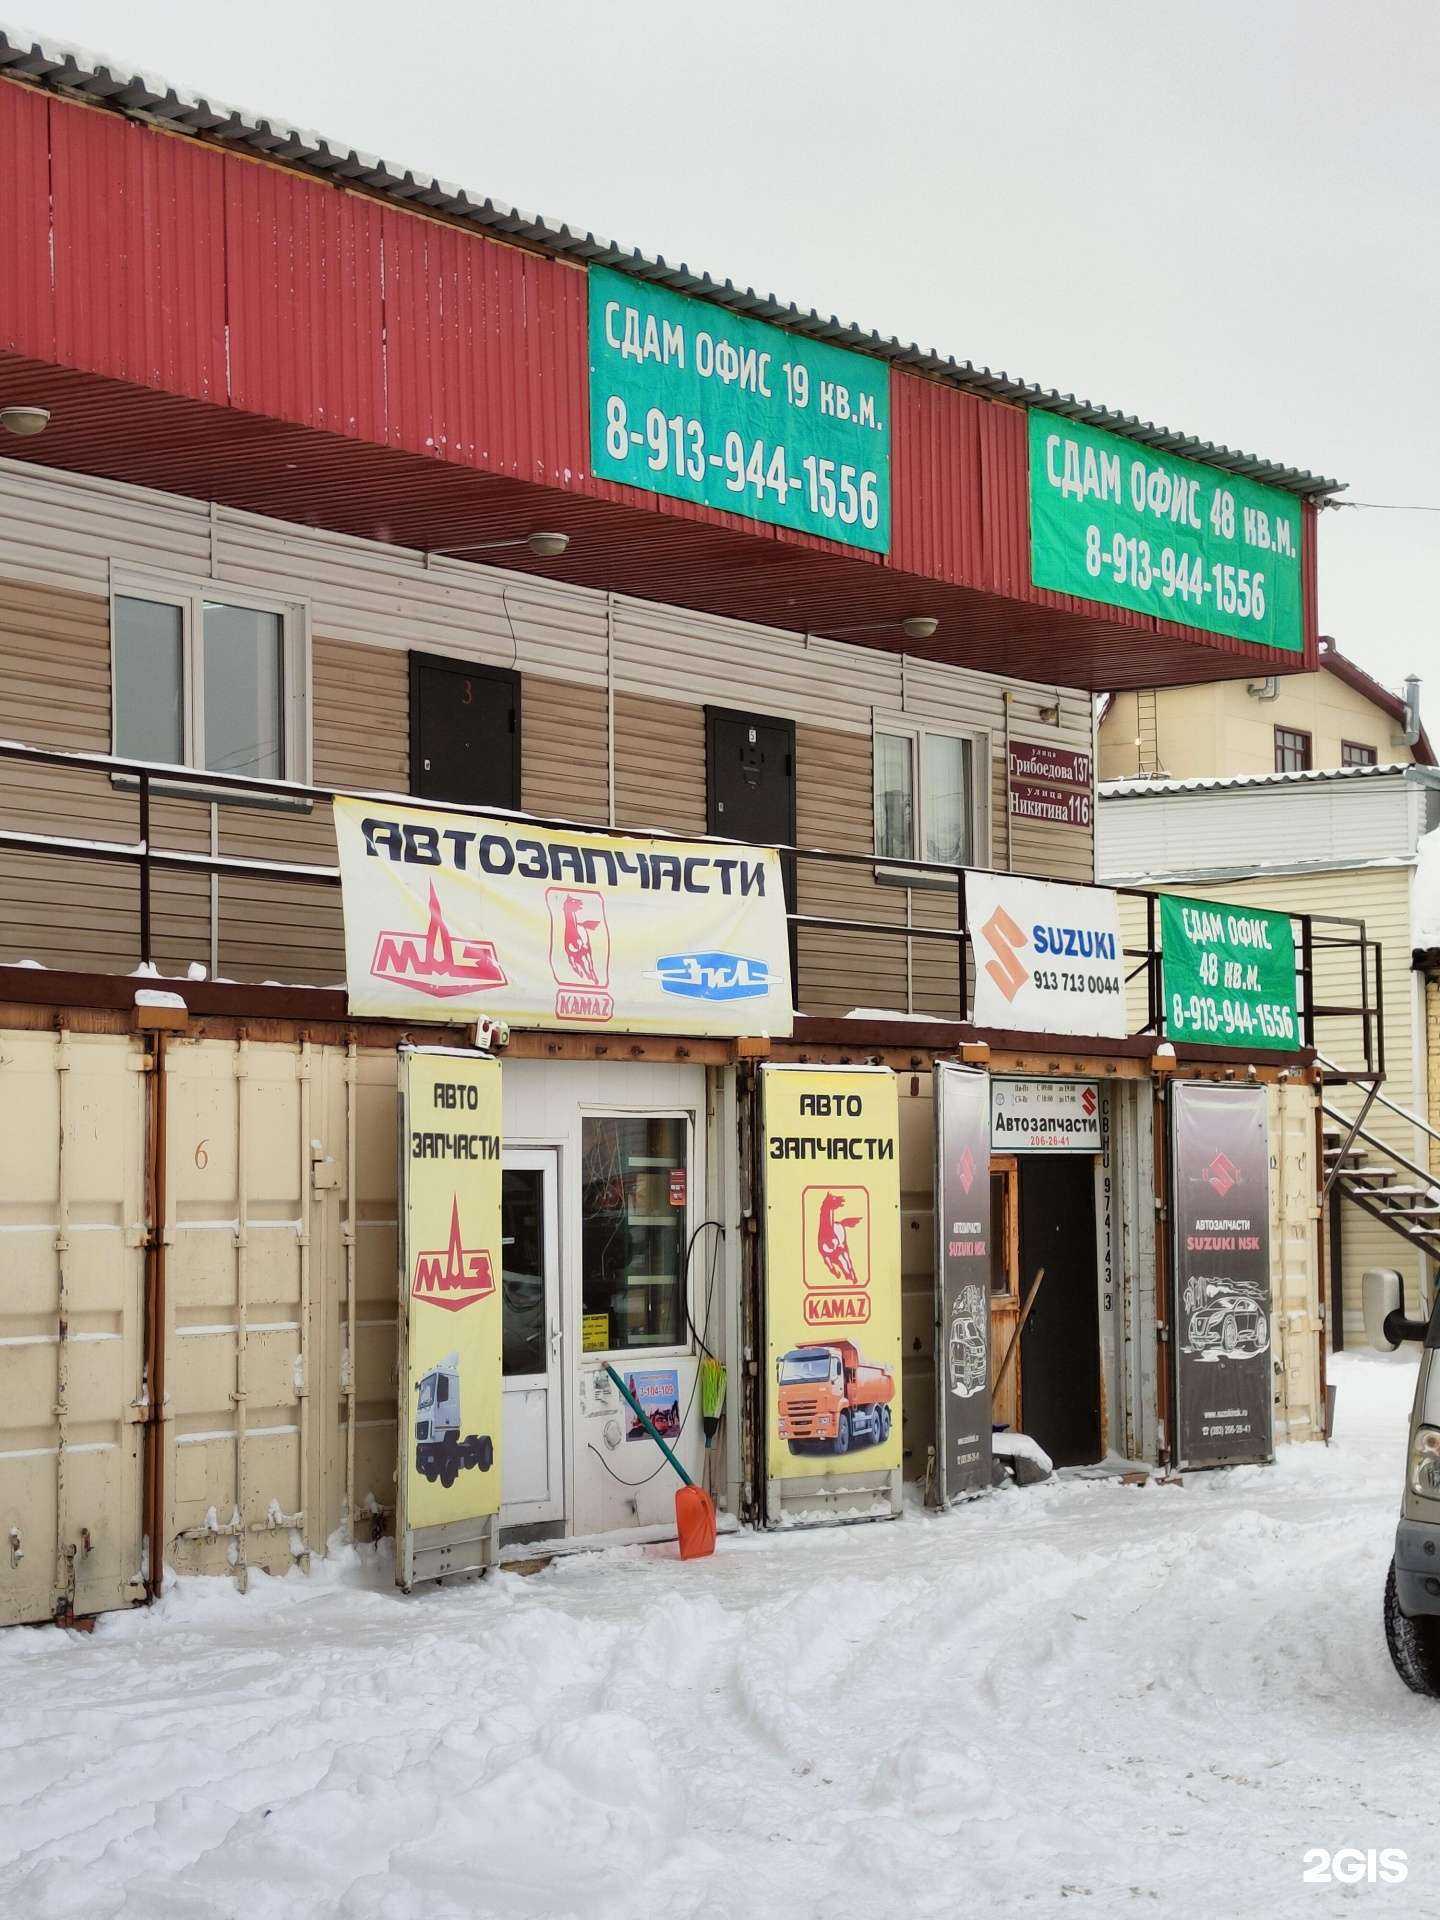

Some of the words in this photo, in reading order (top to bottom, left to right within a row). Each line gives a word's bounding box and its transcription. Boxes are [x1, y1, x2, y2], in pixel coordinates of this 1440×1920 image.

[605, 301, 685, 368] СДАМ
[696, 332, 771, 397] ОФИС
[783, 363, 809, 407] 19
[606, 396, 879, 529] 8-913-944-1556
[1047, 435, 1121, 504] СДАМ
[1131, 461, 1201, 529] ОФИС
[1210, 488, 1235, 539] 48
[1086, 525, 1265, 620] 8-913-944-1556
[1010, 754, 1073, 780] Грибоедова
[1074, 757, 1088, 782] 137
[1027, 788, 1062, 799] улица
[1010, 792, 1068, 820] Никитина
[1069, 795, 1089, 824] 116
[361, 818, 765, 896] АВТОЗАПЧАСТИ
[1033, 925, 1115, 960] SUZUKI
[1183, 908, 1223, 945] СДАМ
[1228, 915, 1272, 950] ОФИС
[1034, 971, 1058, 990] 913
[1062, 973, 1085, 992] 713
[1088, 975, 1119, 994] 0044
[1200, 952, 1218, 987] 48
[559, 995, 610, 1016] KAMAZ
[1172, 993, 1294, 1040] 8-913-944-1556
[434, 1083, 478, 1110] АВТО
[800, 1094, 862, 1117] АВТО
[996, 1112, 1098, 1133] Автозапчасти
[195, 1139, 209, 1169] 6
[412, 1132, 499, 1160] ЗАПЧАСТИ
[770, 1137, 894, 1160] ЗАПЧАСТИ
[1196, 1220, 1250, 1230] АВТОЗАПЧАСТИ
[1187, 1237, 1235, 1250] SUZUKI
[1239, 1237, 1260, 1250] NSK
[808, 1299, 866, 1319] KAMAZ
